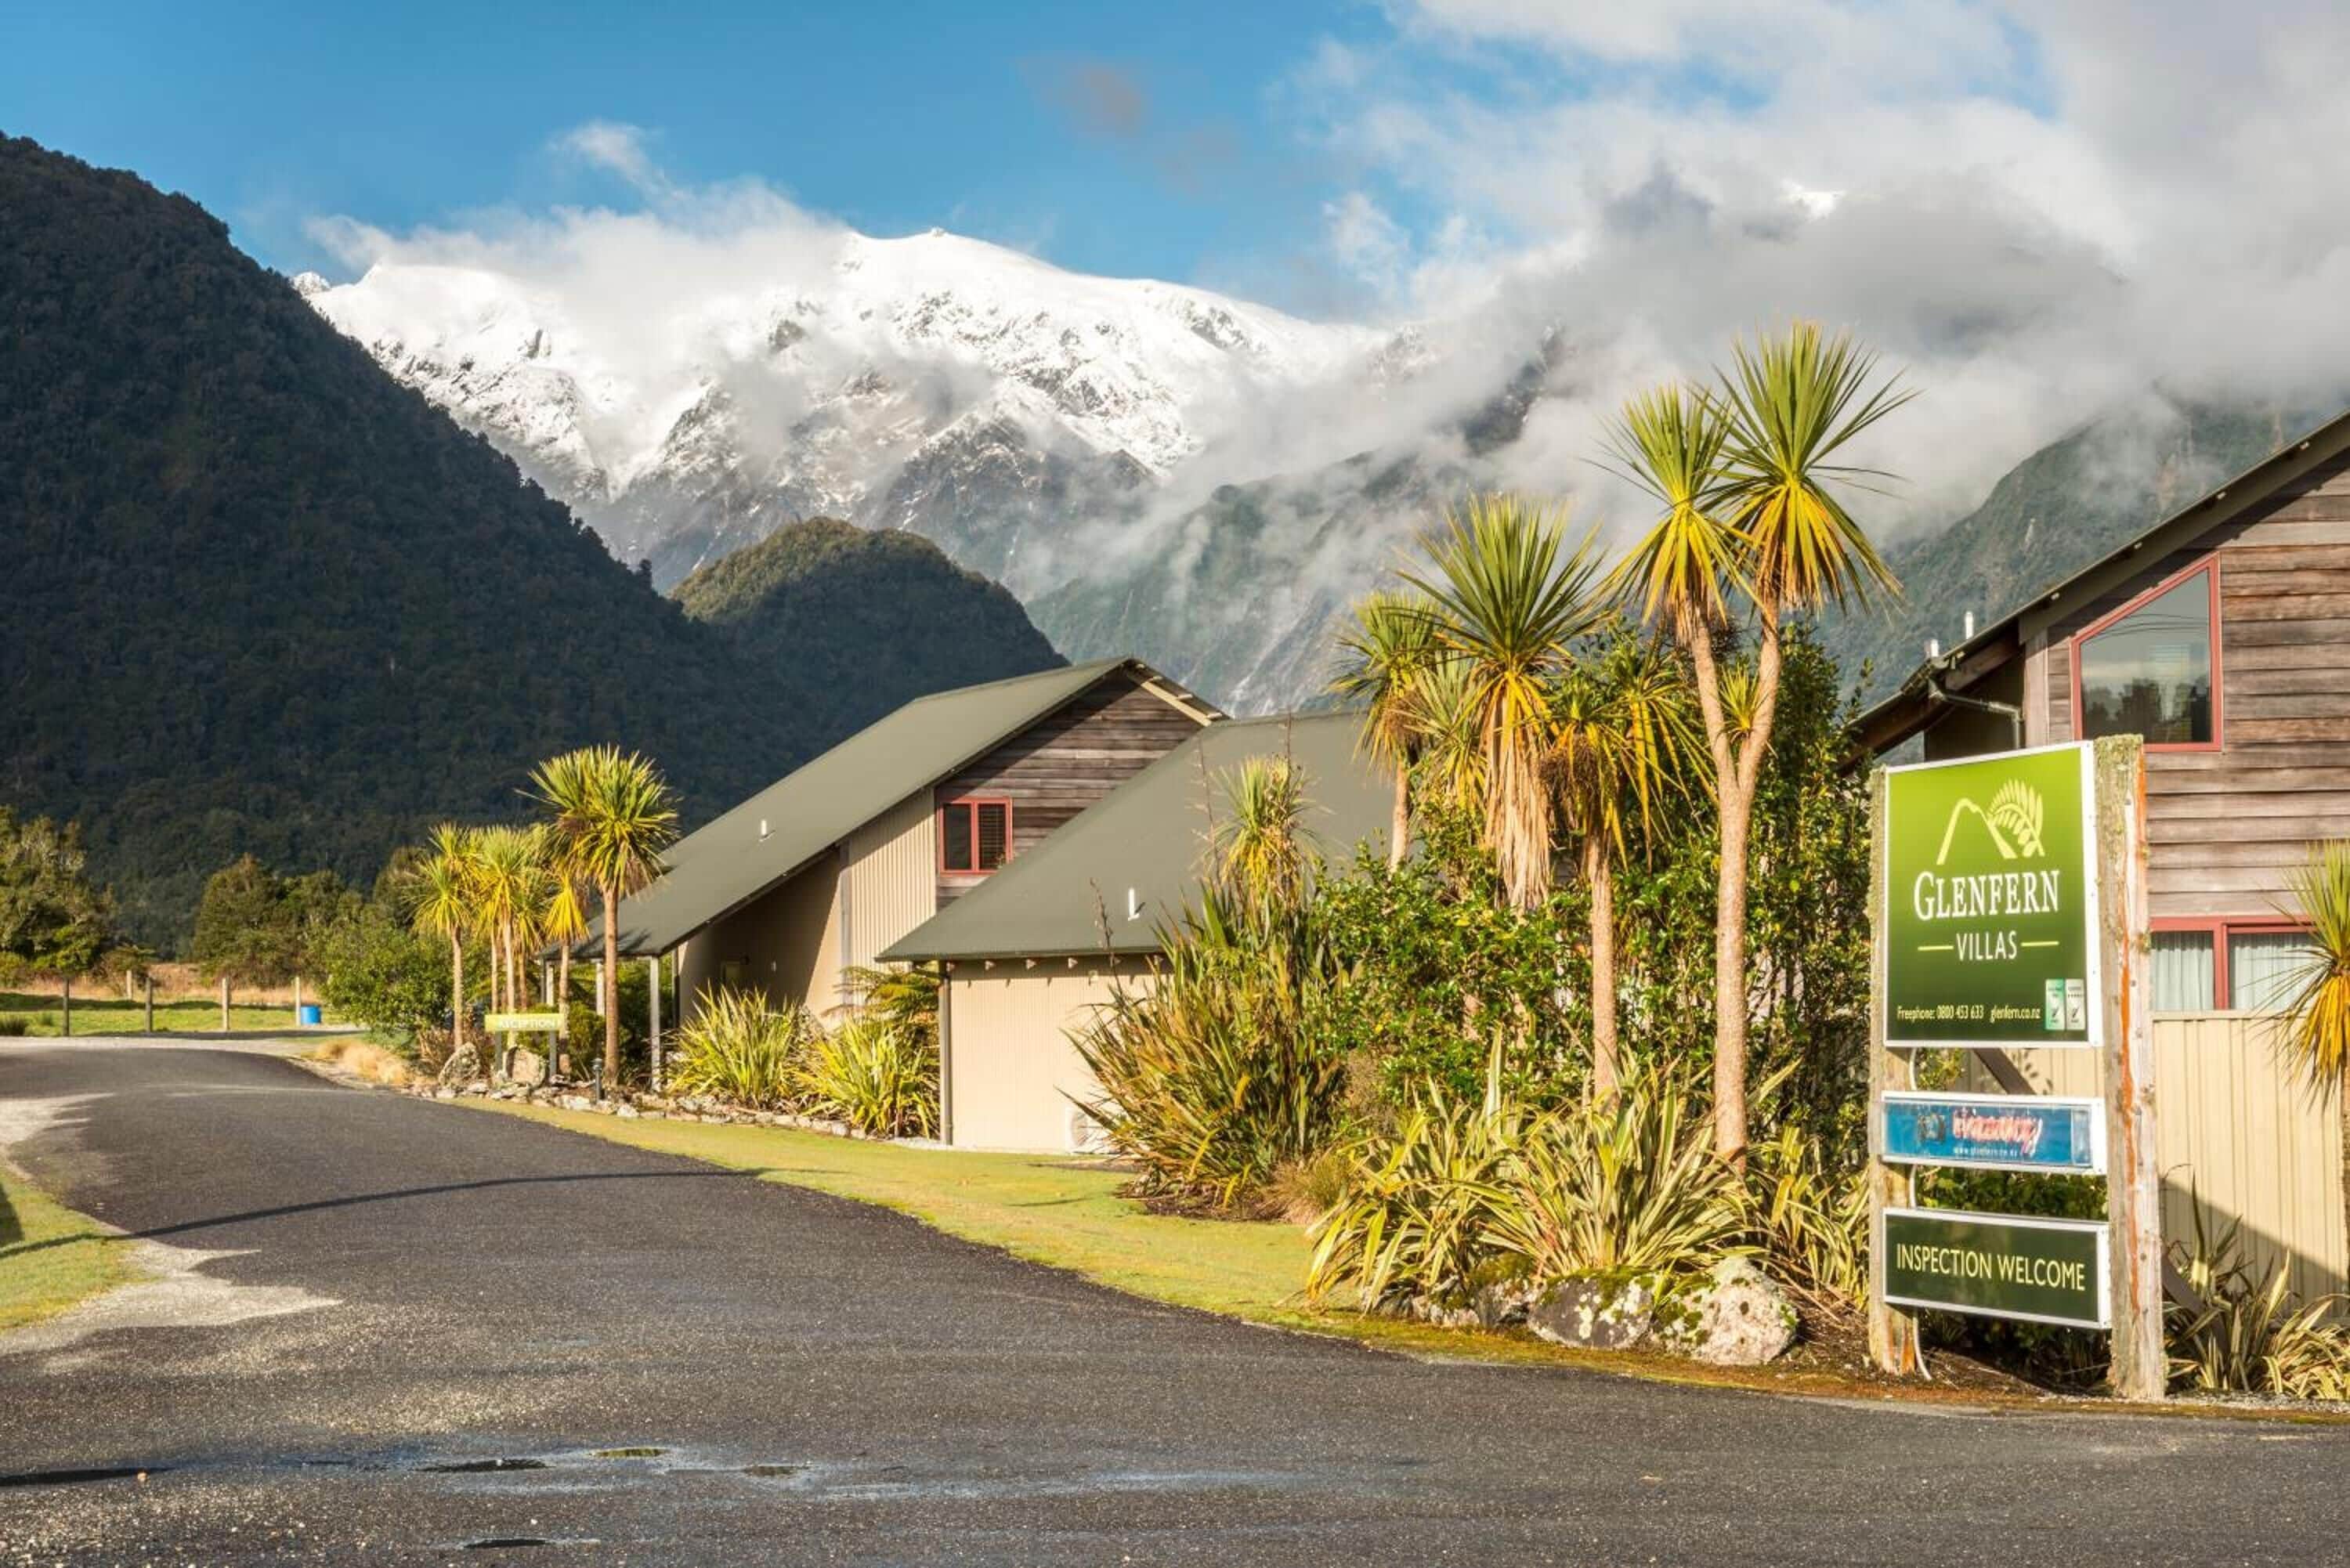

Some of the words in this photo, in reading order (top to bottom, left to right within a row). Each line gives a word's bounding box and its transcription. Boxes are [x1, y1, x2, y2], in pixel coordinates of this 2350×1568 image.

[1914, 869, 2060, 921] GLENFERN
[1956, 930, 2018, 961] VILLAS
[1896, 1006, 1936, 1023] Freephone:
[1937, 1005, 1954, 1019] 0800
[1956, 1005, 1969, 1019] 453
[1970, 1004, 1984, 1019] 633
[1990, 1005, 2041, 1024] glenfern.co.nz
[1896, 1242, 1992, 1280] INSPECTION
[1997, 1253, 2086, 1292] WELCOME
